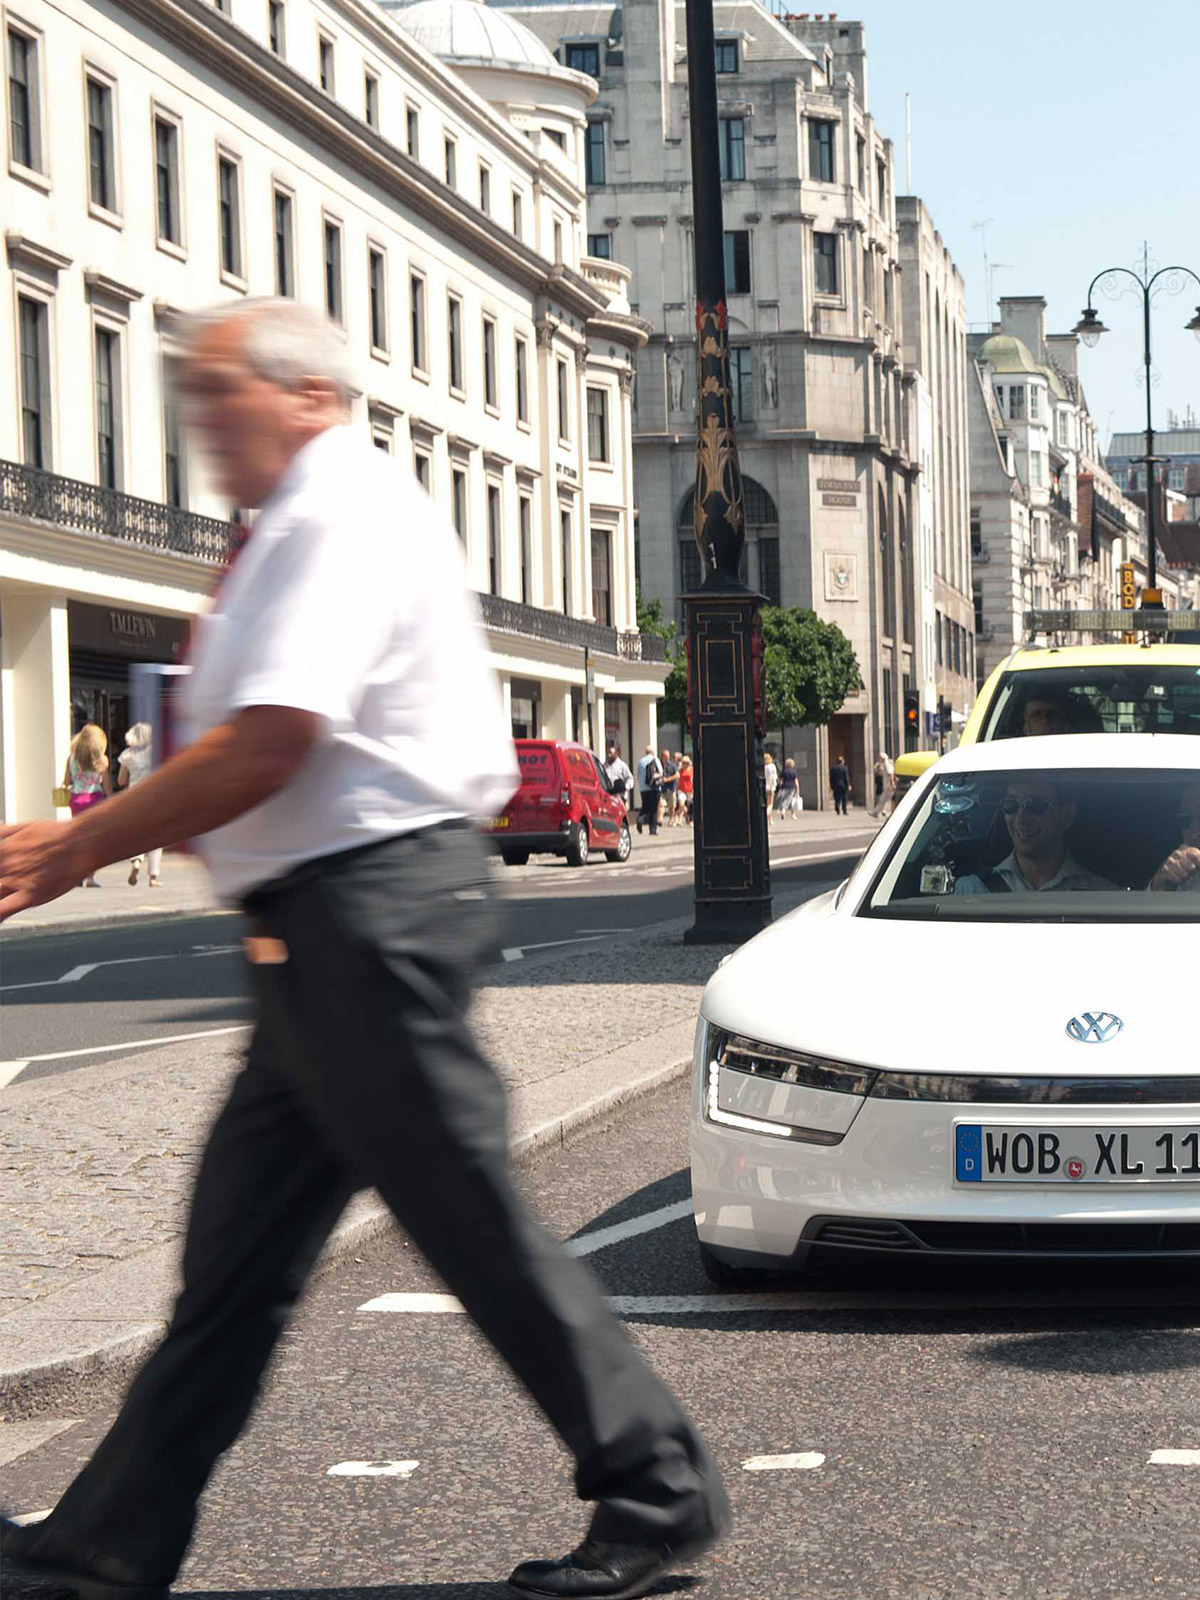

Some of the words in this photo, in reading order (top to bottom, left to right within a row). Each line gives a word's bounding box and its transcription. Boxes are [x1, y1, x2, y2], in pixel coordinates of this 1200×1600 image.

[965, 1158, 975, 1171] D
[985, 1132, 1061, 1175] WOB
[1094, 1132, 1144, 1175] XL
